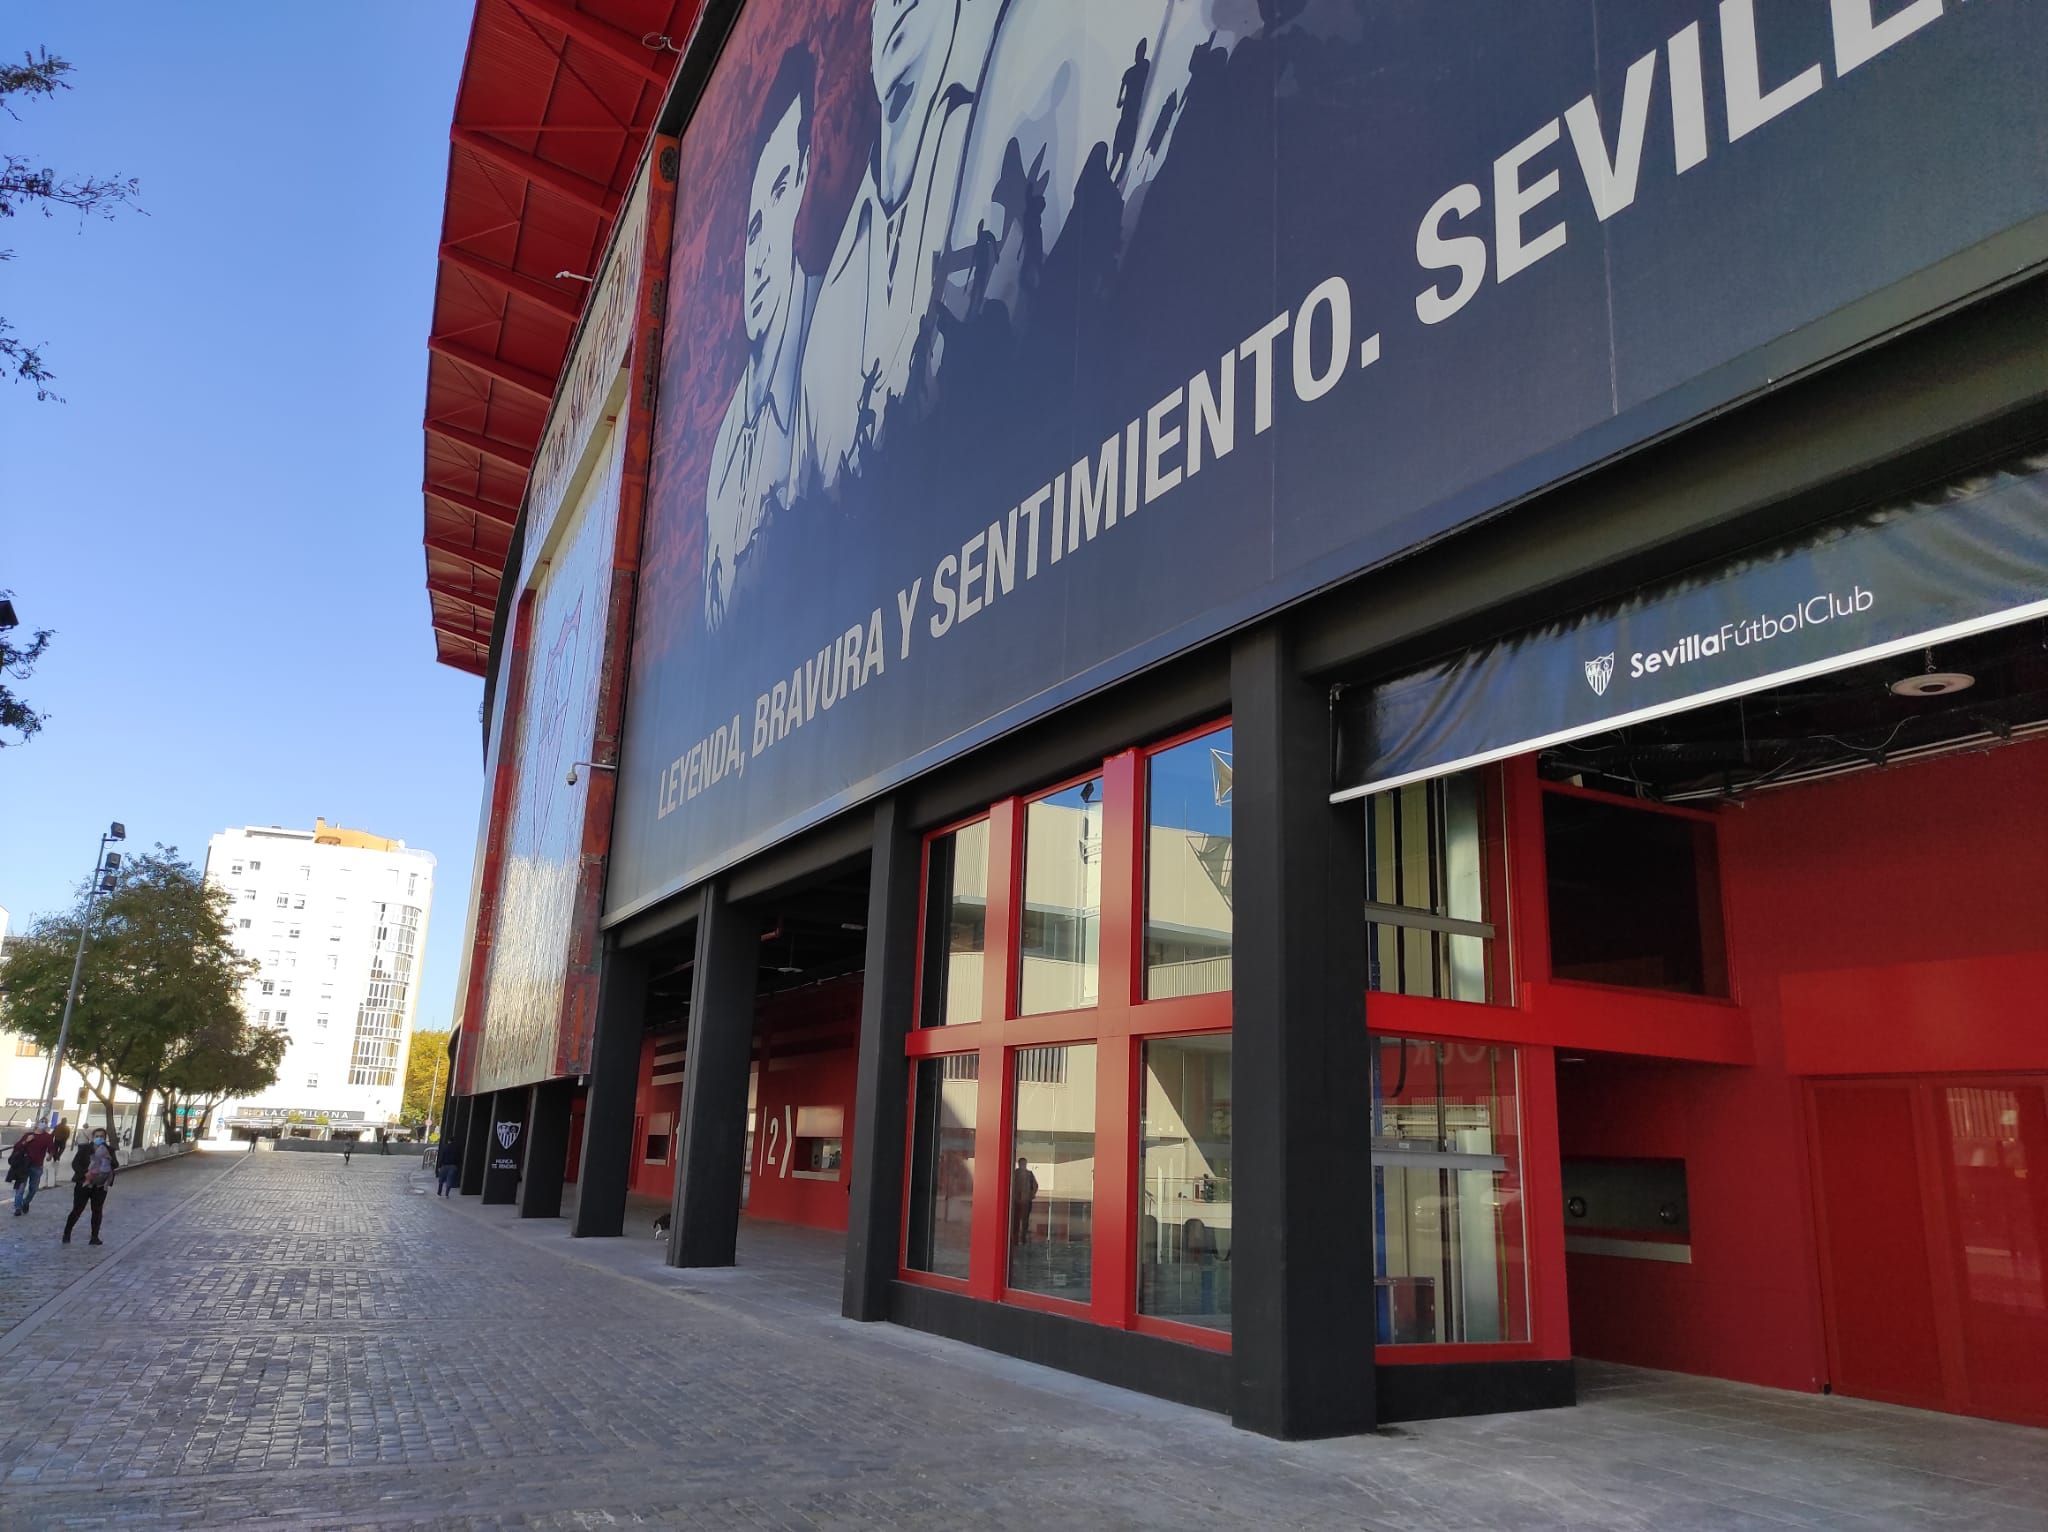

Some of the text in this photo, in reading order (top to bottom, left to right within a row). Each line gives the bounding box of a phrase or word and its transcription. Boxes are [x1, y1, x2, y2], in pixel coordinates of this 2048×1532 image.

[657, 714, 745, 820] LEYENDA,
[752, 607, 884, 758] BRAVURA
[897, 577, 922, 660] Y
[930, 276, 1380, 638] SENTIMIENTO.
[767, 1117, 779, 1165] 2
